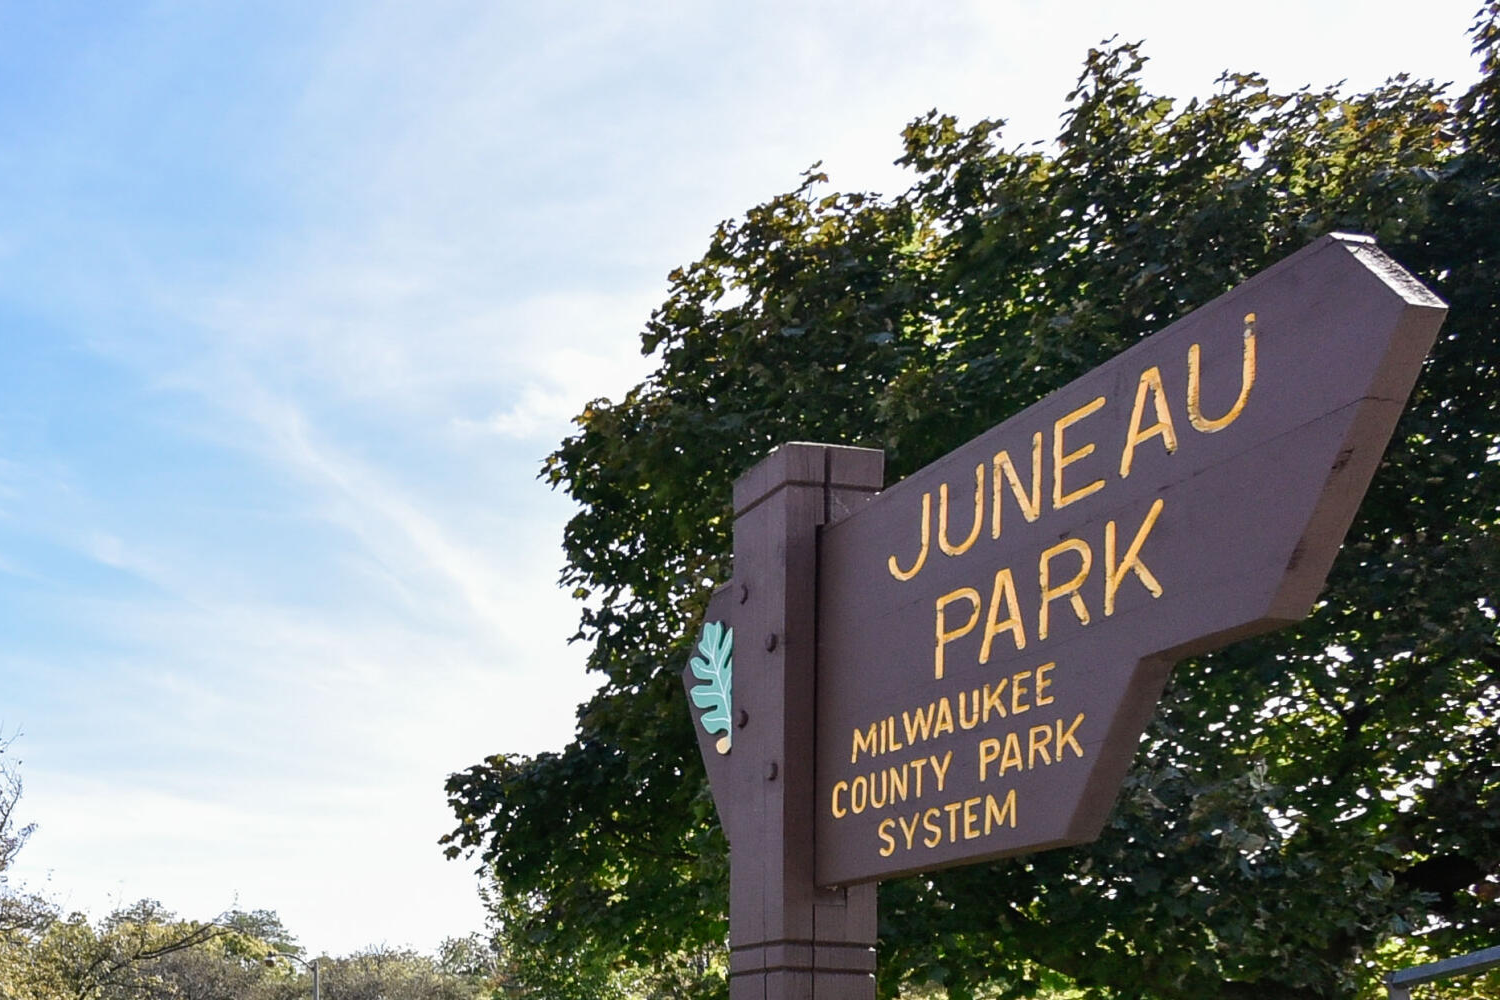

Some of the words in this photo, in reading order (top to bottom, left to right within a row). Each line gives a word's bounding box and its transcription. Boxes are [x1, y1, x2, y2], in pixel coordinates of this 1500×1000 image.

[888, 313, 1257, 581] JUNEAU
[934, 499, 1164, 680] PARK
[851, 662, 1055, 763] MILWAUKEE
[831, 751, 953, 819] COUNTY
[979, 713, 1084, 780] PARK
[878, 789, 1017, 857] SYSTEM
